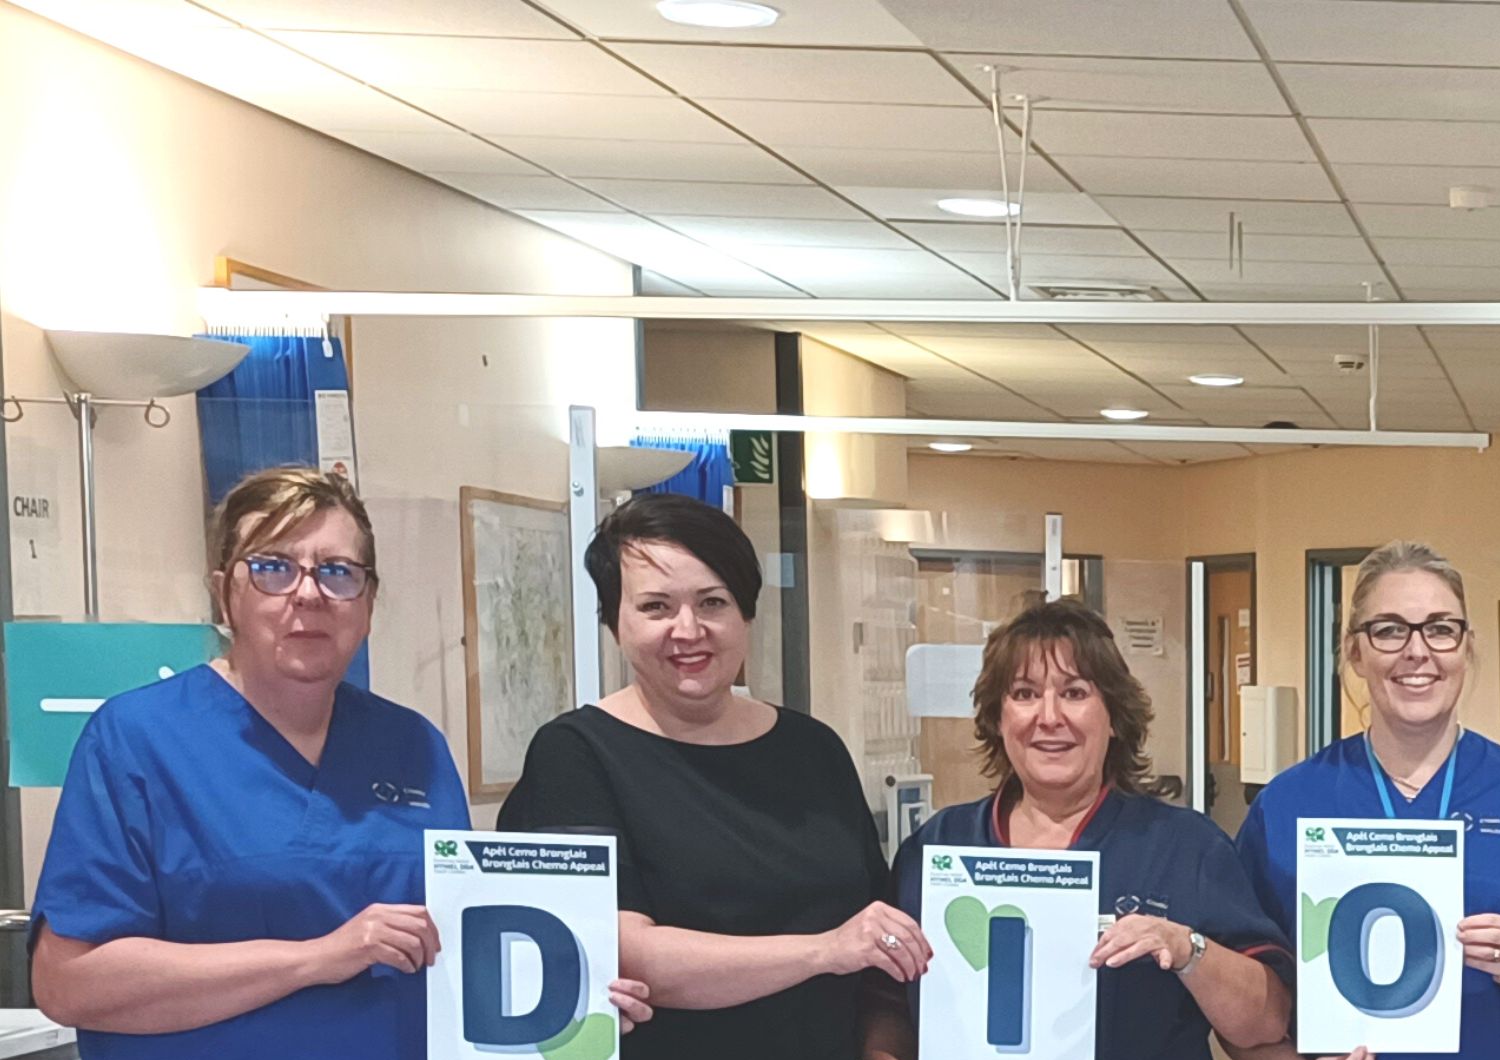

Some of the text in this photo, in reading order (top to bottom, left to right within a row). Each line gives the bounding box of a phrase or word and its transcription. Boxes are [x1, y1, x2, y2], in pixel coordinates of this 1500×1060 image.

[13, 496, 50, 518] CHAIR
[29, 540, 37, 558] 1
[508, 846, 537, 857] Cemo
[540, 848, 587, 860] Bronglais
[482, 858, 530, 871] Bronglais
[532, 860, 568, 870] Chemo
[569, 861, 606, 872] Appeal
[999, 862, 1027, 871] Cemo
[1028, 863, 1072, 875] Bronglais
[975, 873, 1019, 884] Bronglais
[1020, 874, 1054, 884] Chemo
[1055, 875, 1089, 886] Appeal
[1328, 882, 1438, 1011] O
[462, 905, 581, 1046] D
[987, 916, 1026, 1046] I
